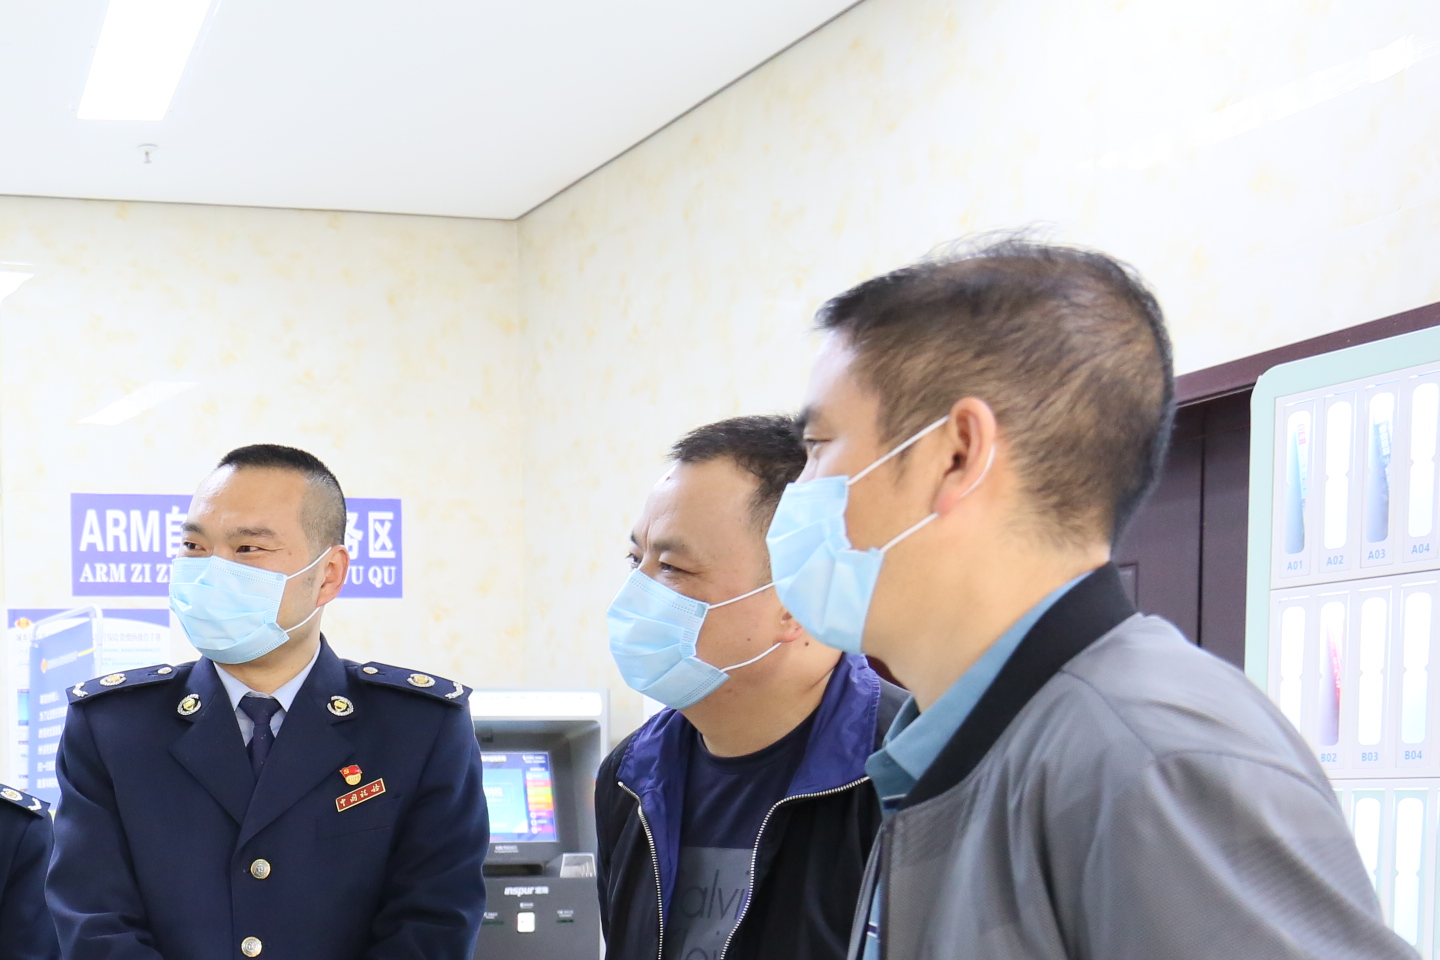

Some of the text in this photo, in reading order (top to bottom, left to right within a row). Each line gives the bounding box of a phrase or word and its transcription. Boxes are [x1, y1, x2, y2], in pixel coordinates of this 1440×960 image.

[1411, 543, 1430, 555] A04
[1367, 549, 1386, 560] A03
[1326, 555, 1344, 566] A02
[1286, 561, 1303, 571] A01
[79, 563, 127, 583] ARM
[131, 563, 152, 583] ZI
[368, 565, 396, 588] QU
[1320, 753, 1337, 763] B02
[1361, 752, 1378, 762] B03
[1404, 750, 1423, 760] B04
